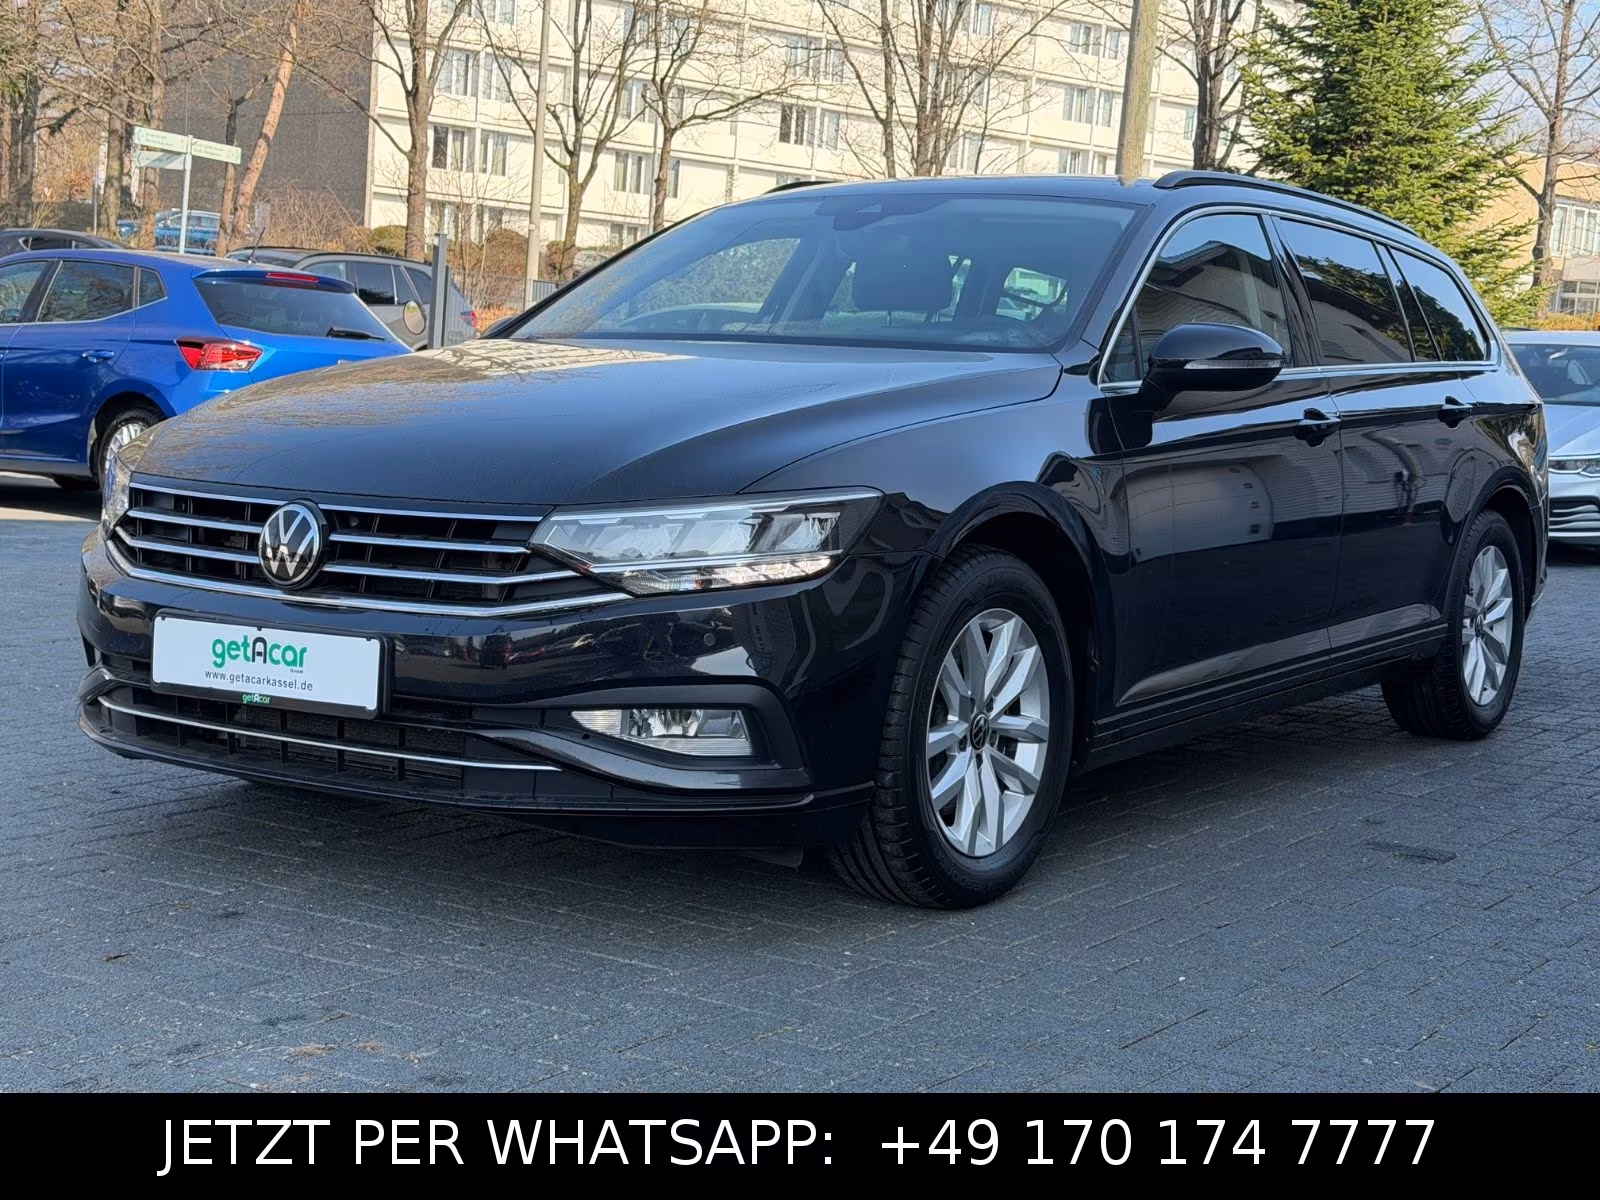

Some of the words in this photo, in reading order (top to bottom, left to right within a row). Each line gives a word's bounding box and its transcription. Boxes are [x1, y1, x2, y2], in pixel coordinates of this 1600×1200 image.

[261, 506, 318, 582] VW
[212, 635, 307, 669] getAcar
[205, 670, 313, 691] www.getacarkassel.de
